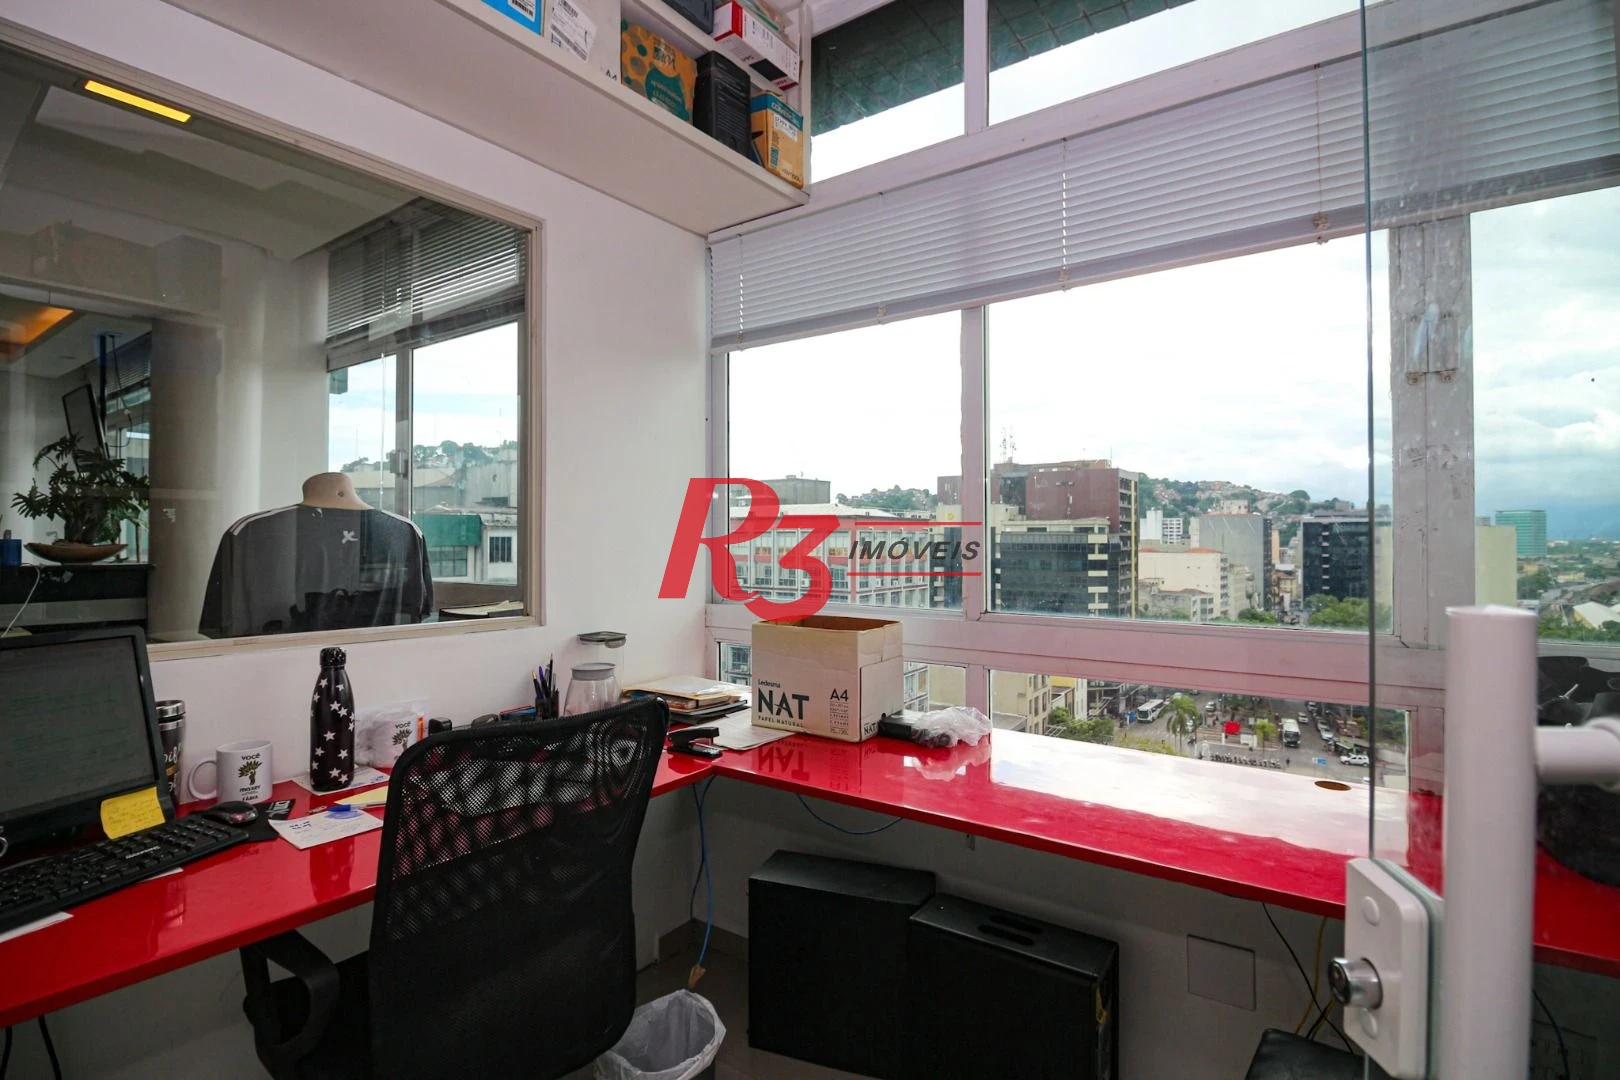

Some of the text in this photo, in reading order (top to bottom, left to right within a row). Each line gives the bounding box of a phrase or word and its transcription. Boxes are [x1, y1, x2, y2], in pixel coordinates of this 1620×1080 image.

[830, 688, 849, 701] A4
[758, 688, 810, 720] NAT
[758, 715, 804, 728] PAPEL NATURAL
